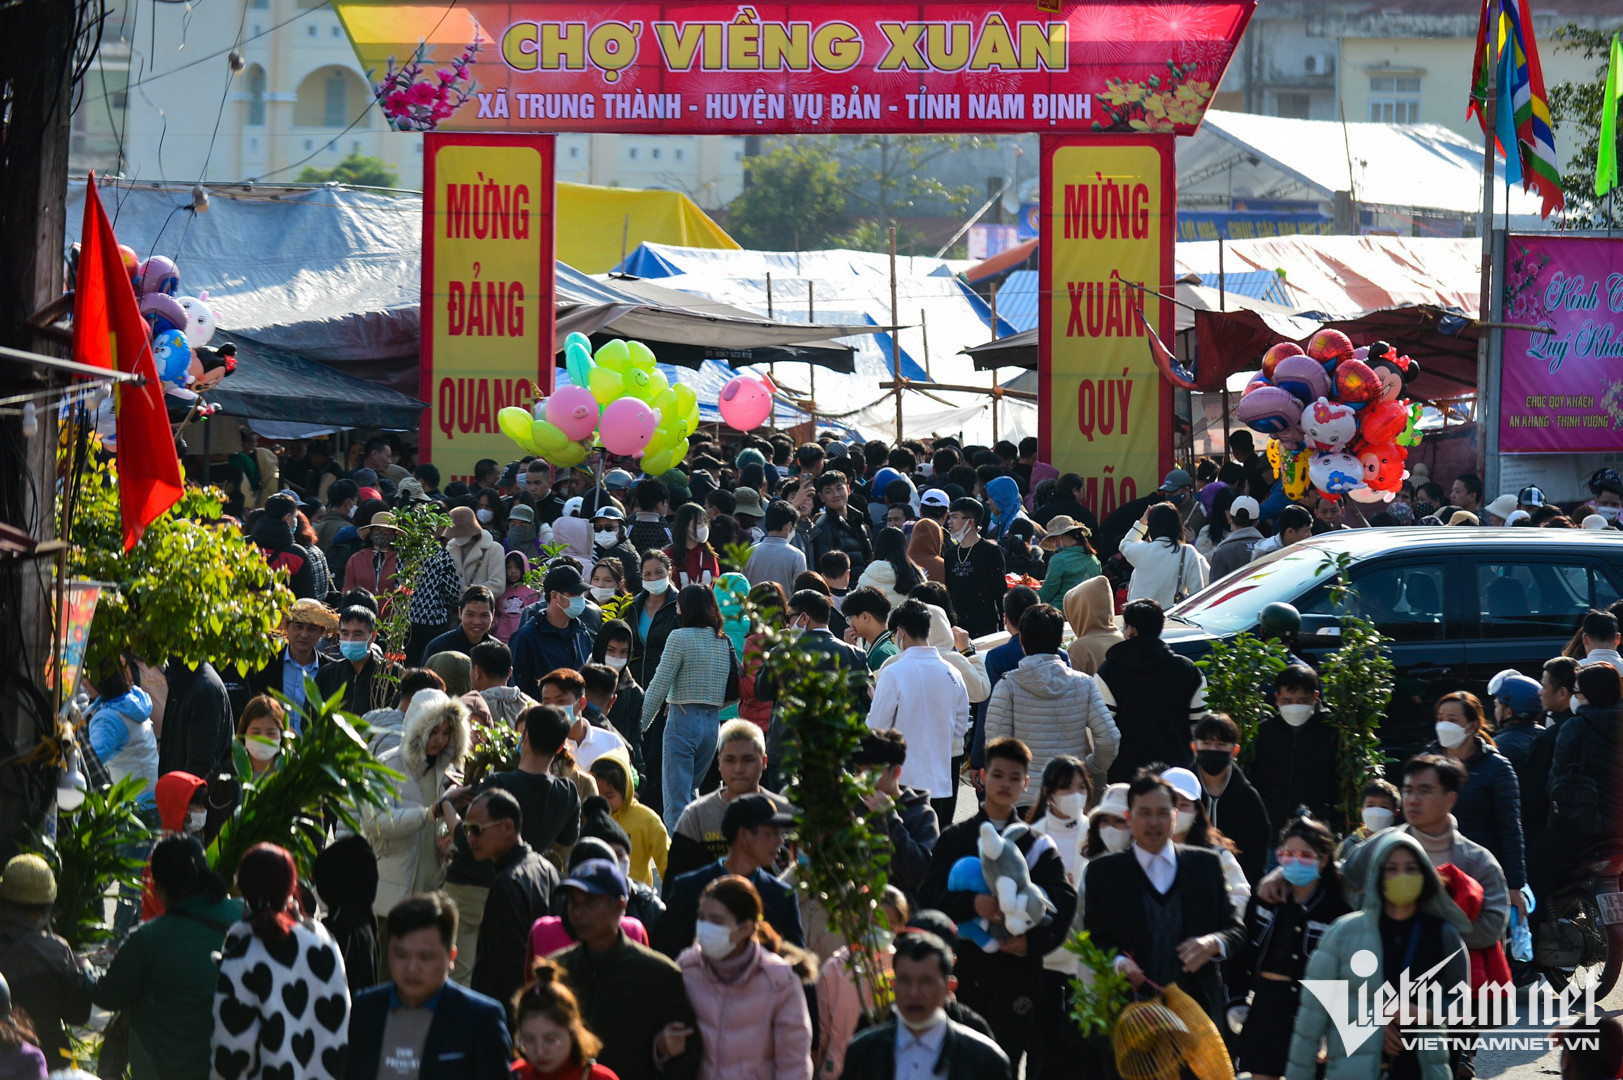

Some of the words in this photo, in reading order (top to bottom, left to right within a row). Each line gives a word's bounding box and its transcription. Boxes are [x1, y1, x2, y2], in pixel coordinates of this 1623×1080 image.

[500, 20, 643, 84] CHỢ
[651, 5, 863, 72] VIỀNG
[874, 12, 1069, 72] XUÂN
[477, 88, 510, 119] XÃ
[517, 92, 595, 119] TRUNG
[602, 88, 682, 119] THÀNH
[706, 87, 784, 125] HUYỆN
[792, 93, 823, 125] VỤ
[831, 85, 881, 119] BẢN
[905, 85, 961, 119] TỈNH
[968, 93, 1025, 119] NAM
[1032, 93, 1092, 125] ĐỊNH
[446, 171, 529, 240] MỪNG
[1063, 171, 1149, 240] MỪNG
[448, 262, 524, 338] ĐẢNG
[1066, 269, 1144, 338] XUÂN
[1544, 271, 1600, 312] Kính
[1605, 272, 1623, 313] C
[439, 376, 531, 440] QUANG
[1078, 367, 1133, 442] QUÝ
[1509, 415, 1520, 428] AN
[1522, 415, 1549, 428] KHANG
[1557, 415, 1581, 430] THỊNH
[1525, 393, 1547, 408] CHÚC
[1549, 393, 1565, 409] QUÝ
[1567, 393, 1594, 408] KHÁCH
